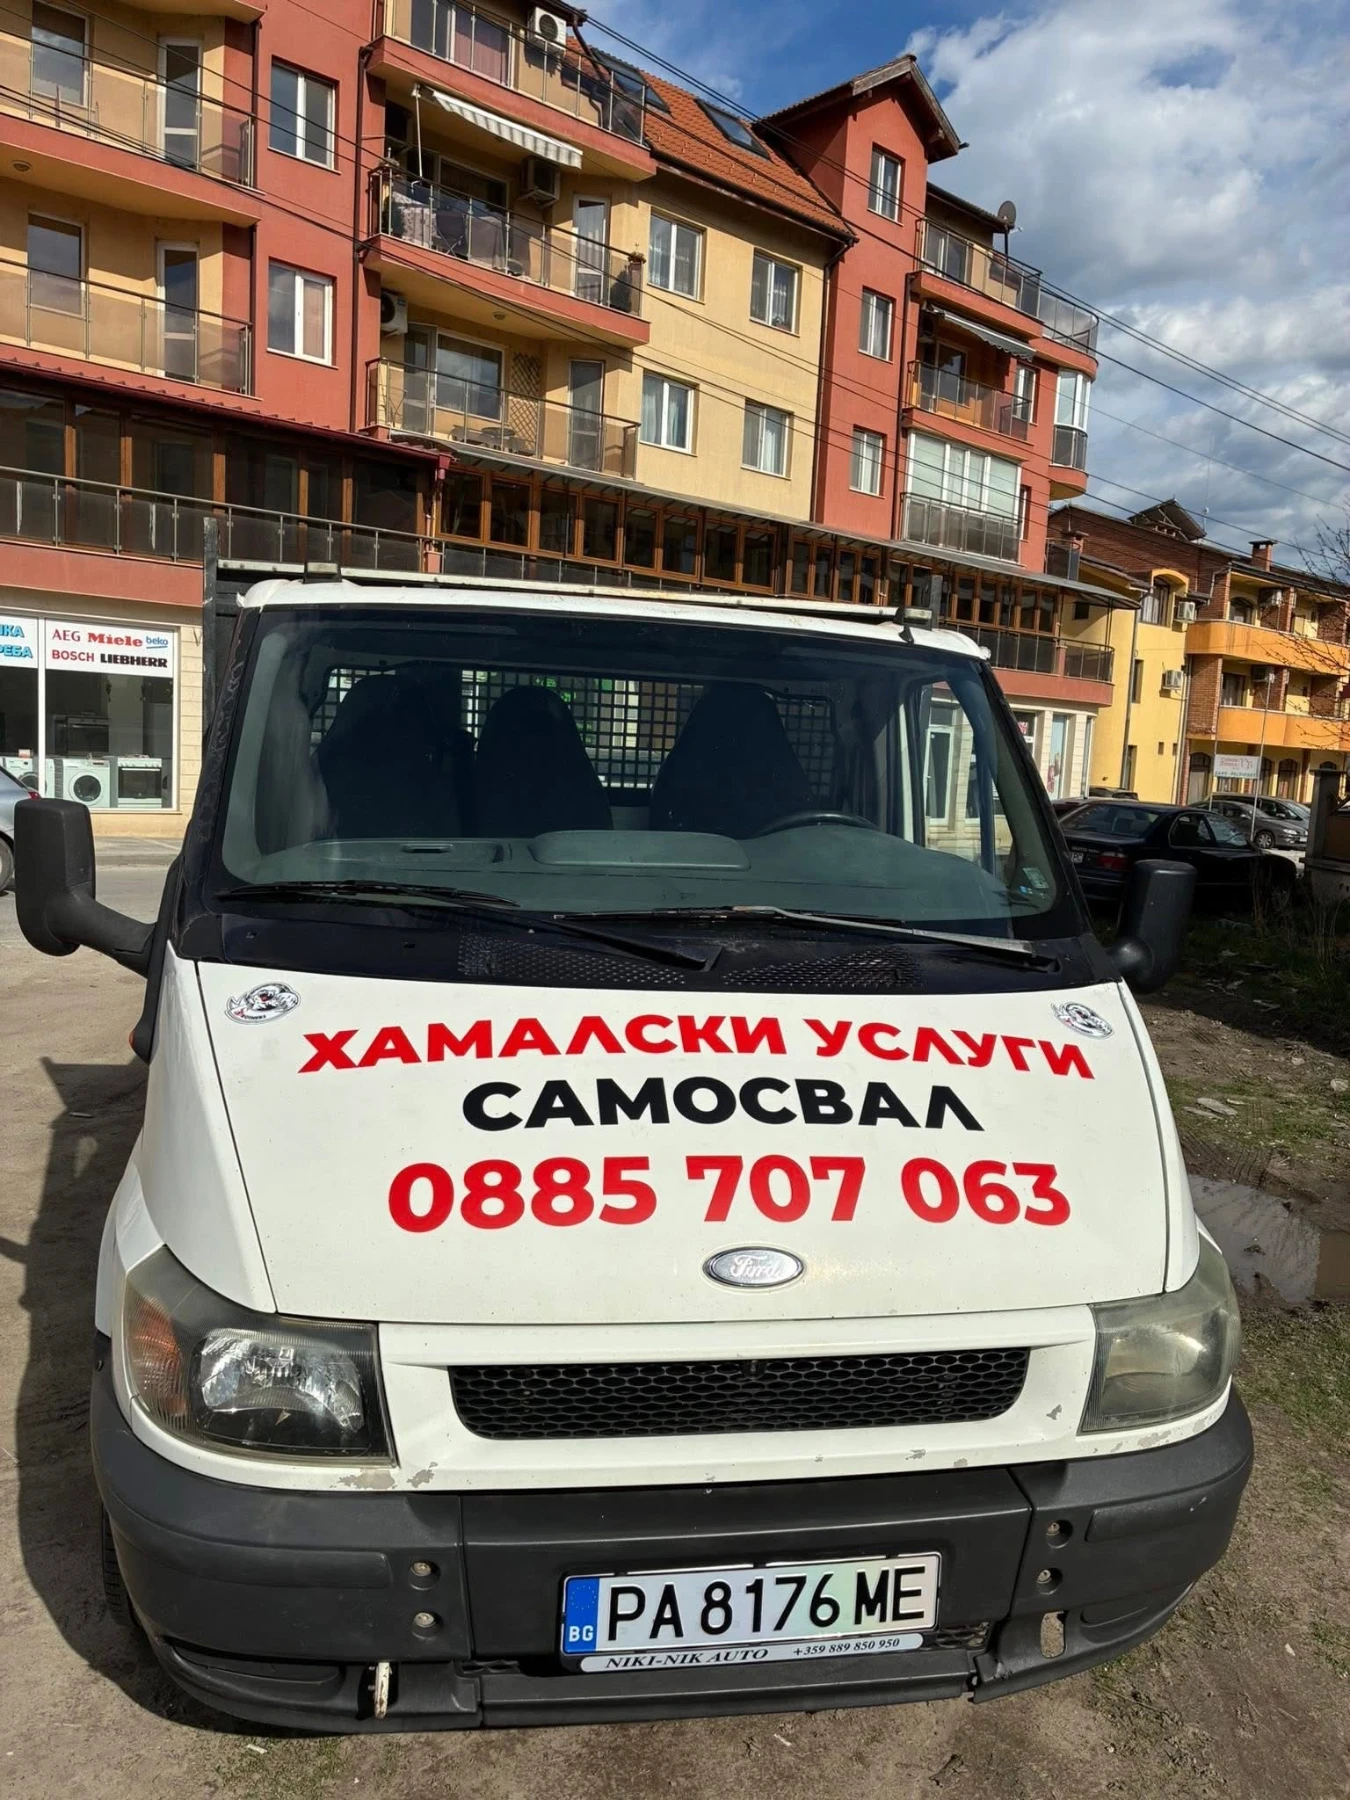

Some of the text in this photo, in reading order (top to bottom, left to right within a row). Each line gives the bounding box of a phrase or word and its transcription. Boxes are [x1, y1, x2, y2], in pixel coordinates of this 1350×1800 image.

[52, 628, 169, 647] AEG Miele beko
[52, 649, 168, 668] BOSCH LIEBHERR
[300, 1014, 1093, 1080] ХАМАЛСКИ УСЛУГИ
[463, 1077, 984, 1131] САМОСВАЛ
[388, 1154, 1070, 1233] 0885 707 063
[731, 1254, 783, 1278] Ford
[607, 1565, 926, 1642] PA 8176 ME
[569, 1625, 594, 1642] BG
[793, 1637, 901, 1657] +359 889 850 950
[605, 1648, 769, 1669] NIKI-NIK AUTO
